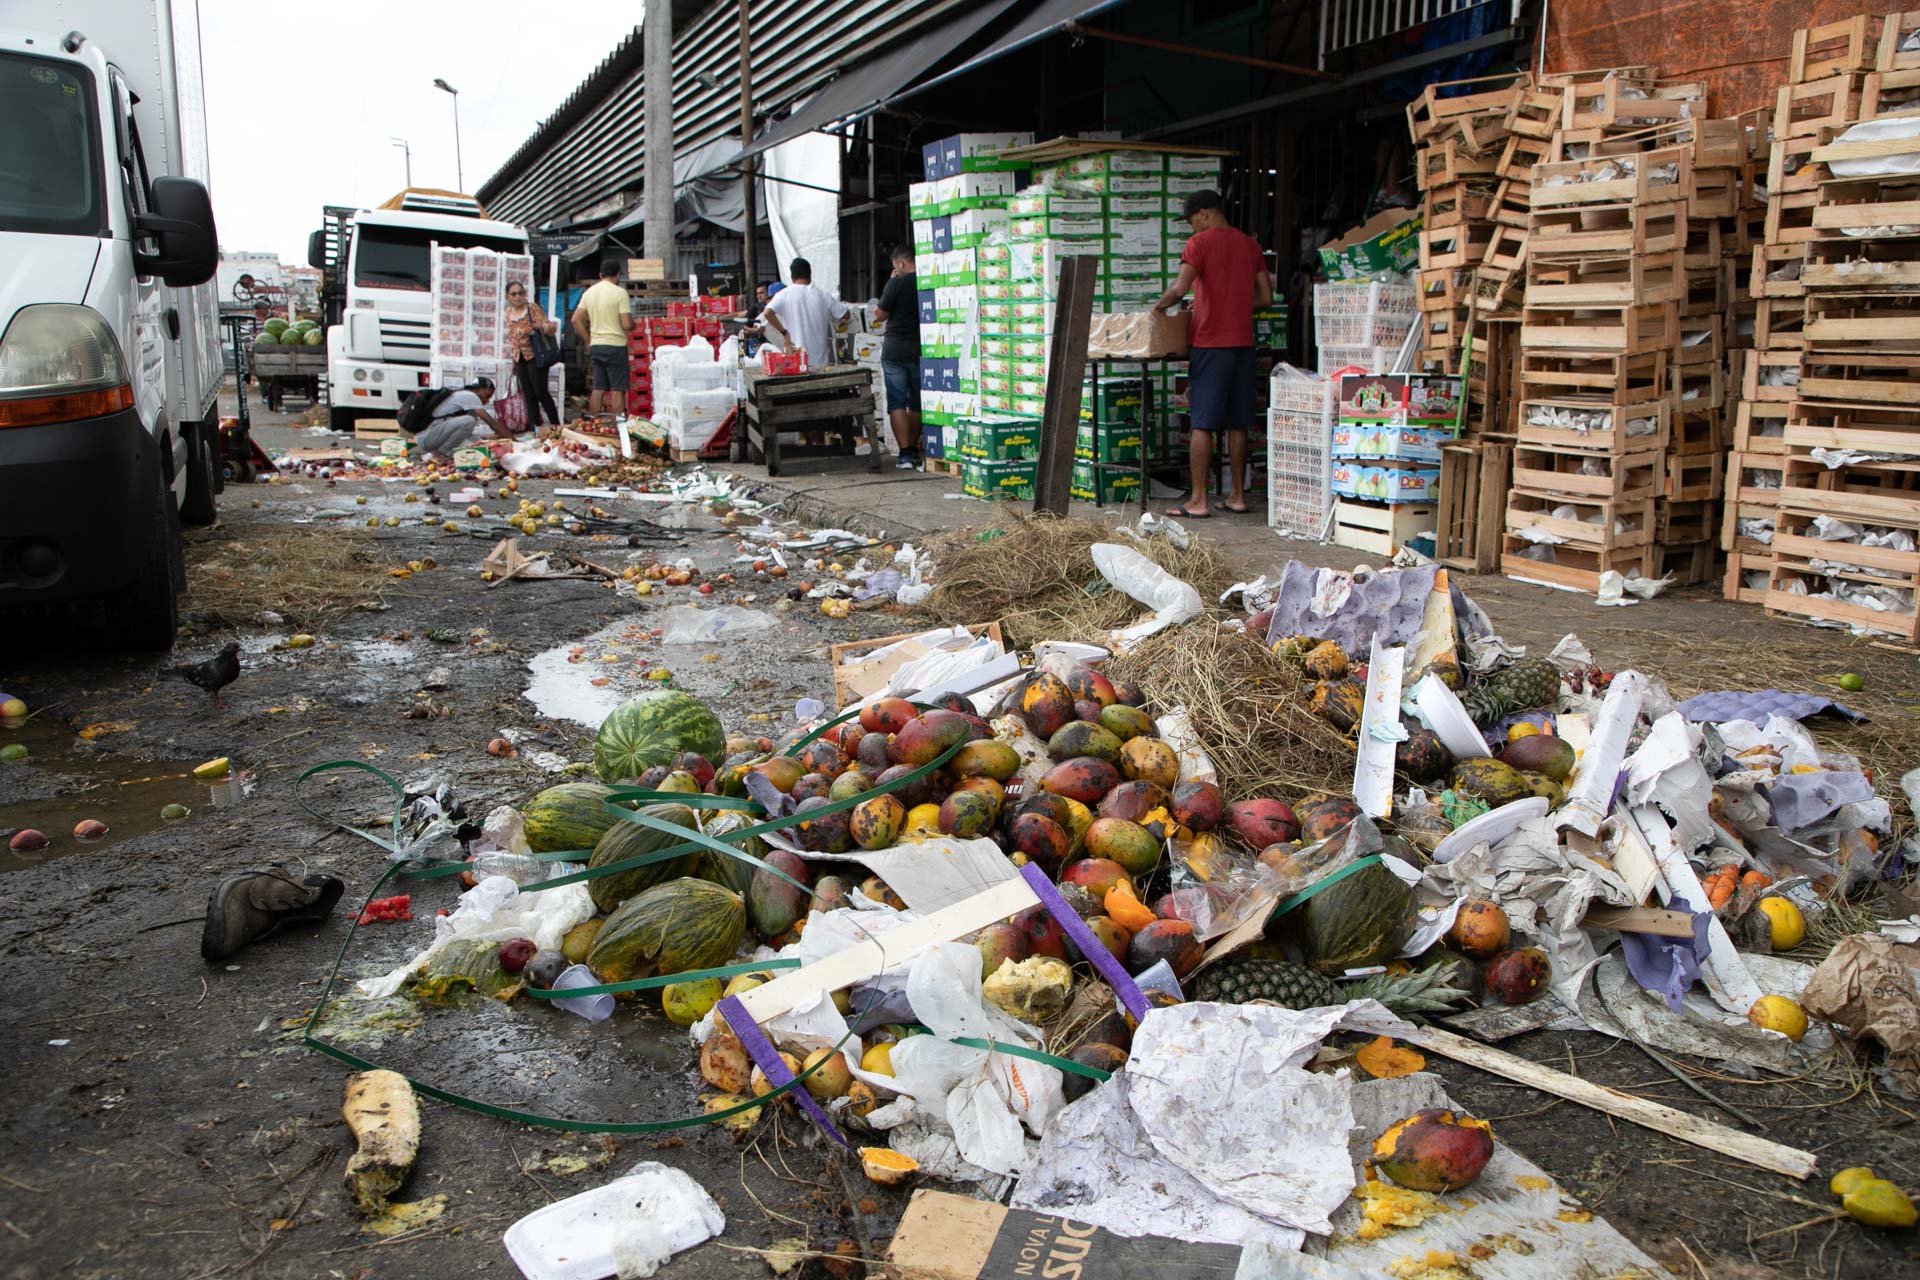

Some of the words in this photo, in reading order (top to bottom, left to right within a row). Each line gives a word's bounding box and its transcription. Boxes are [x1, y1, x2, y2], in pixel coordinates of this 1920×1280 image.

[1334, 468, 1350, 480] Dole
[1401, 476, 1425, 488] Dole
[1014, 1229, 1050, 1275] NOVA
